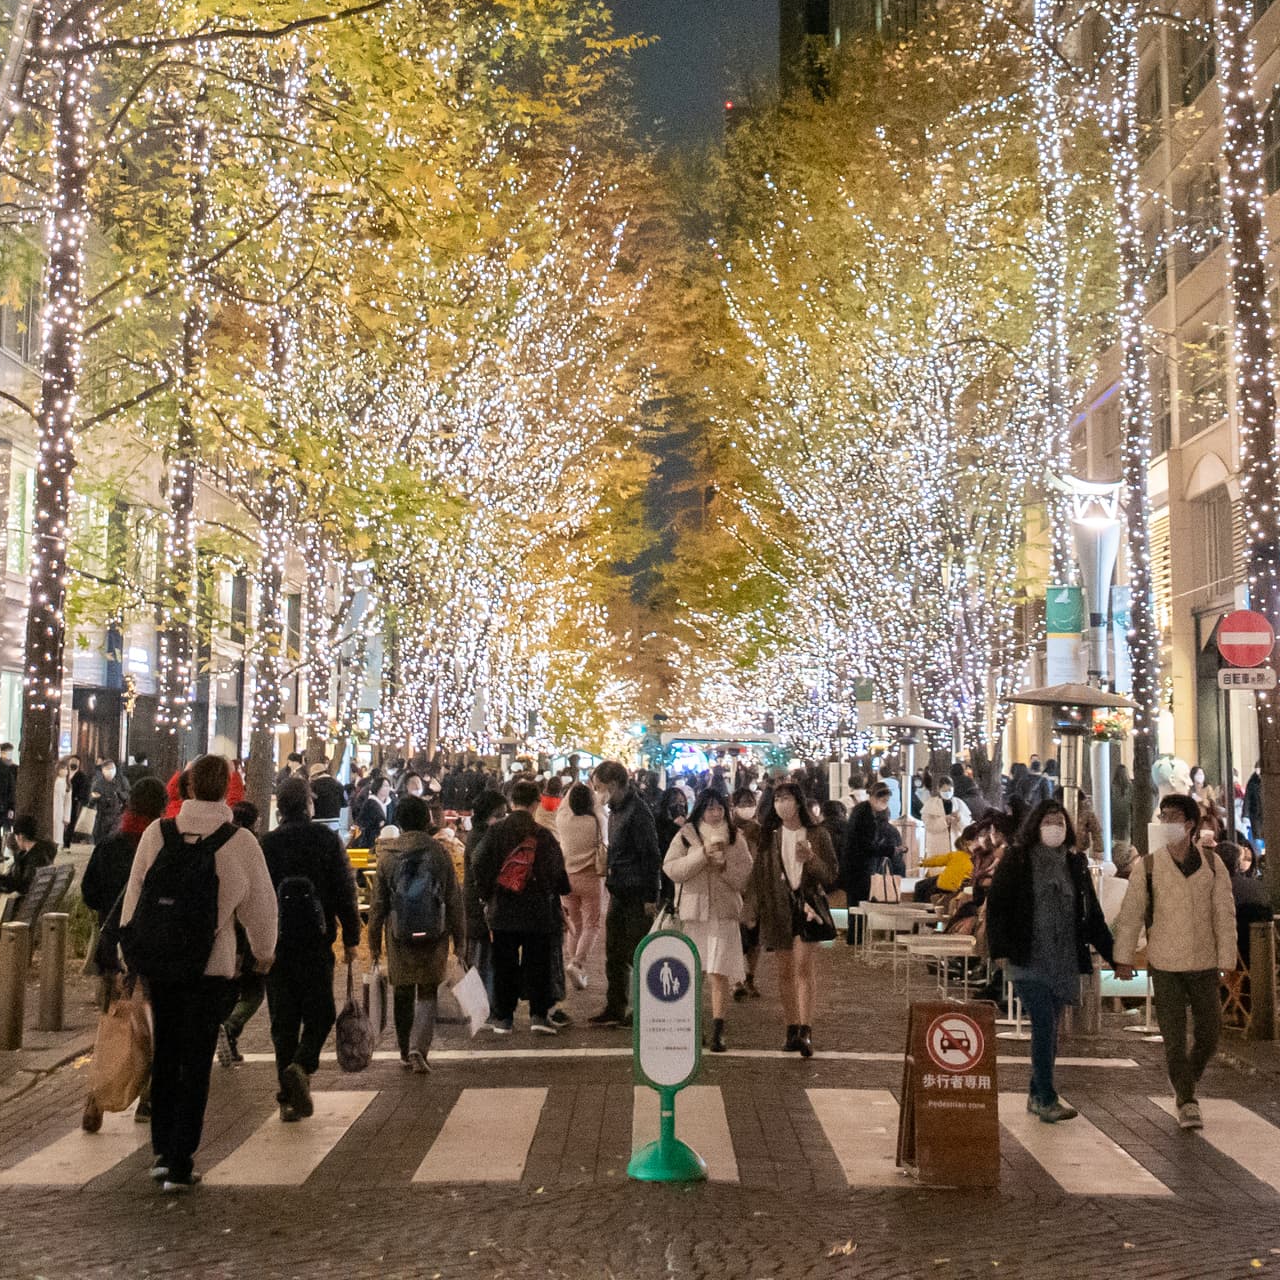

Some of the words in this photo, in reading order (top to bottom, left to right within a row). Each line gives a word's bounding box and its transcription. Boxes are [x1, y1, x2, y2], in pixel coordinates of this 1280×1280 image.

[922, 1074, 991, 1089] 歩行者専用
[928, 1100, 967, 1109] Pedestrian
